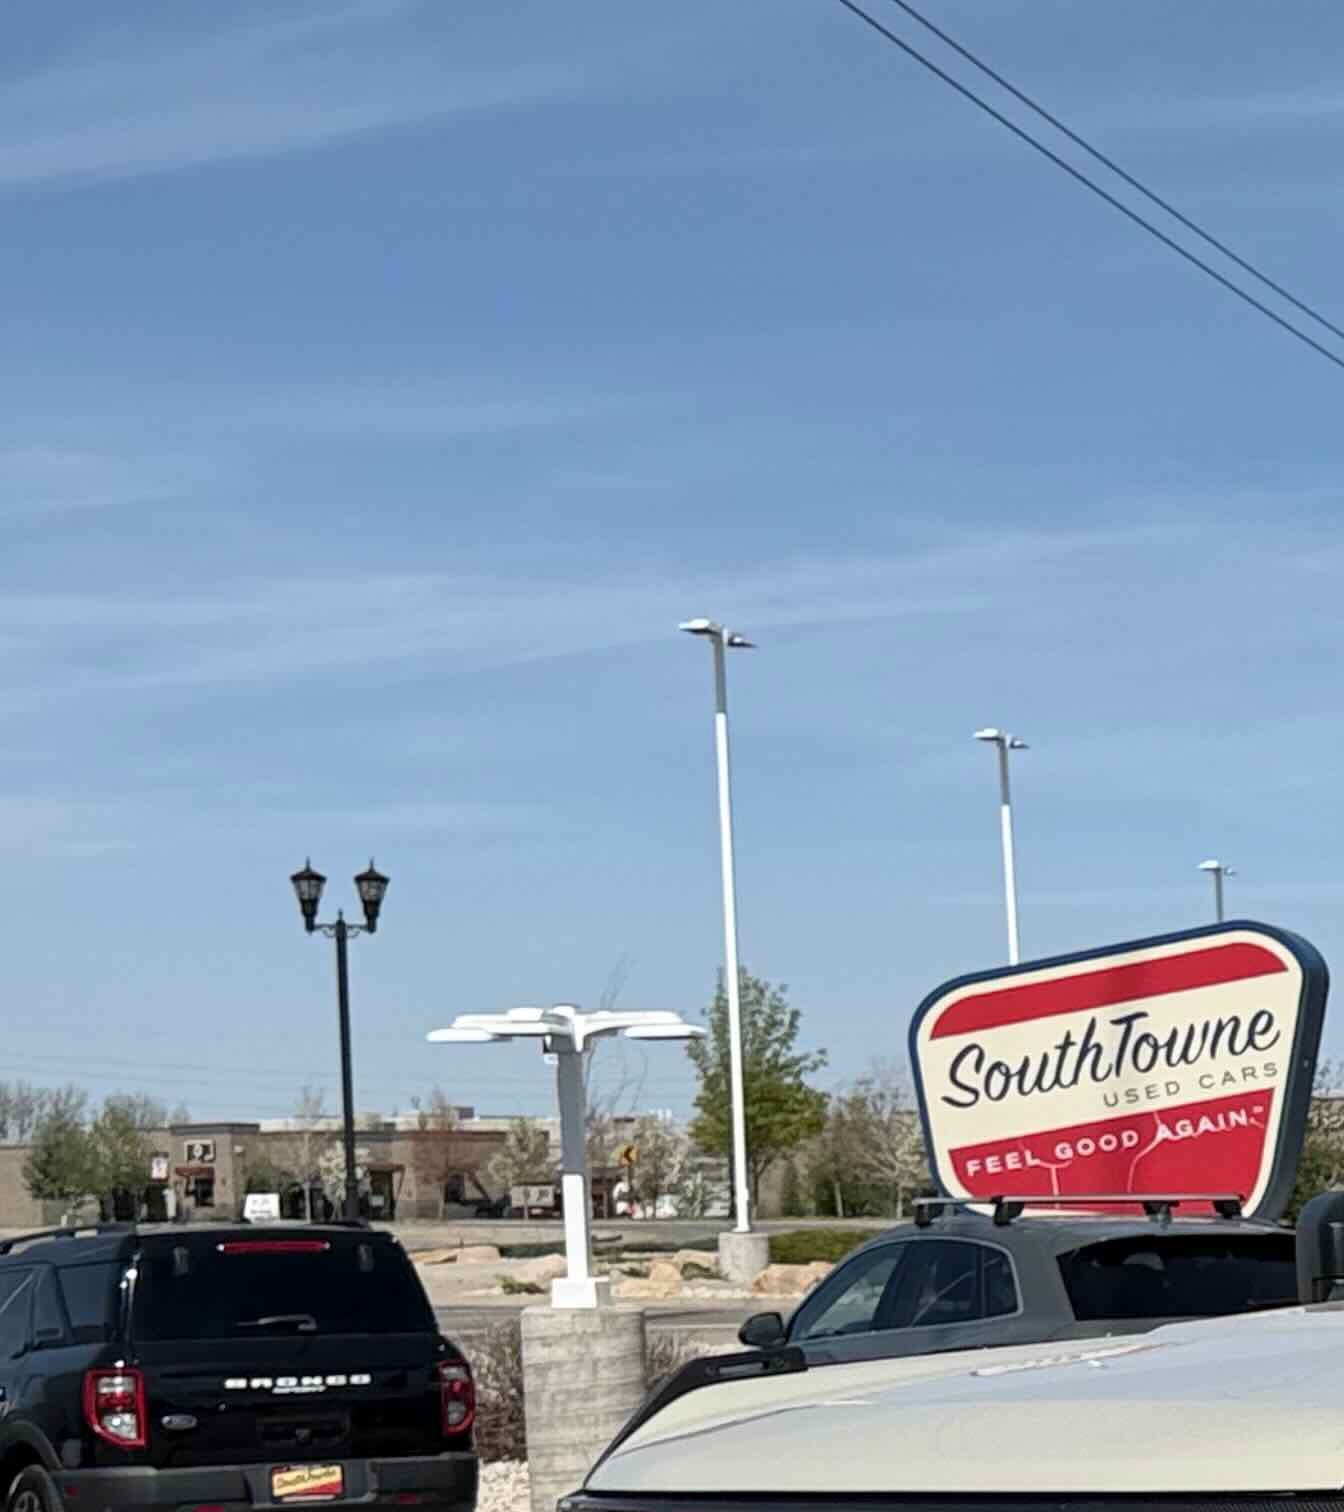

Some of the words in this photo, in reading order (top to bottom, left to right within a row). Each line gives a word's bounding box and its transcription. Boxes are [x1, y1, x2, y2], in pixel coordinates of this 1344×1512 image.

[941, 1009, 1280, 1108] SouthTowne
[1102, 1080, 1180, 1108] USED
[1198, 1062, 1279, 1090] CARS
[965, 1149, 1041, 1177] FEEL
[1054, 1129, 1140, 1160] GOOD
